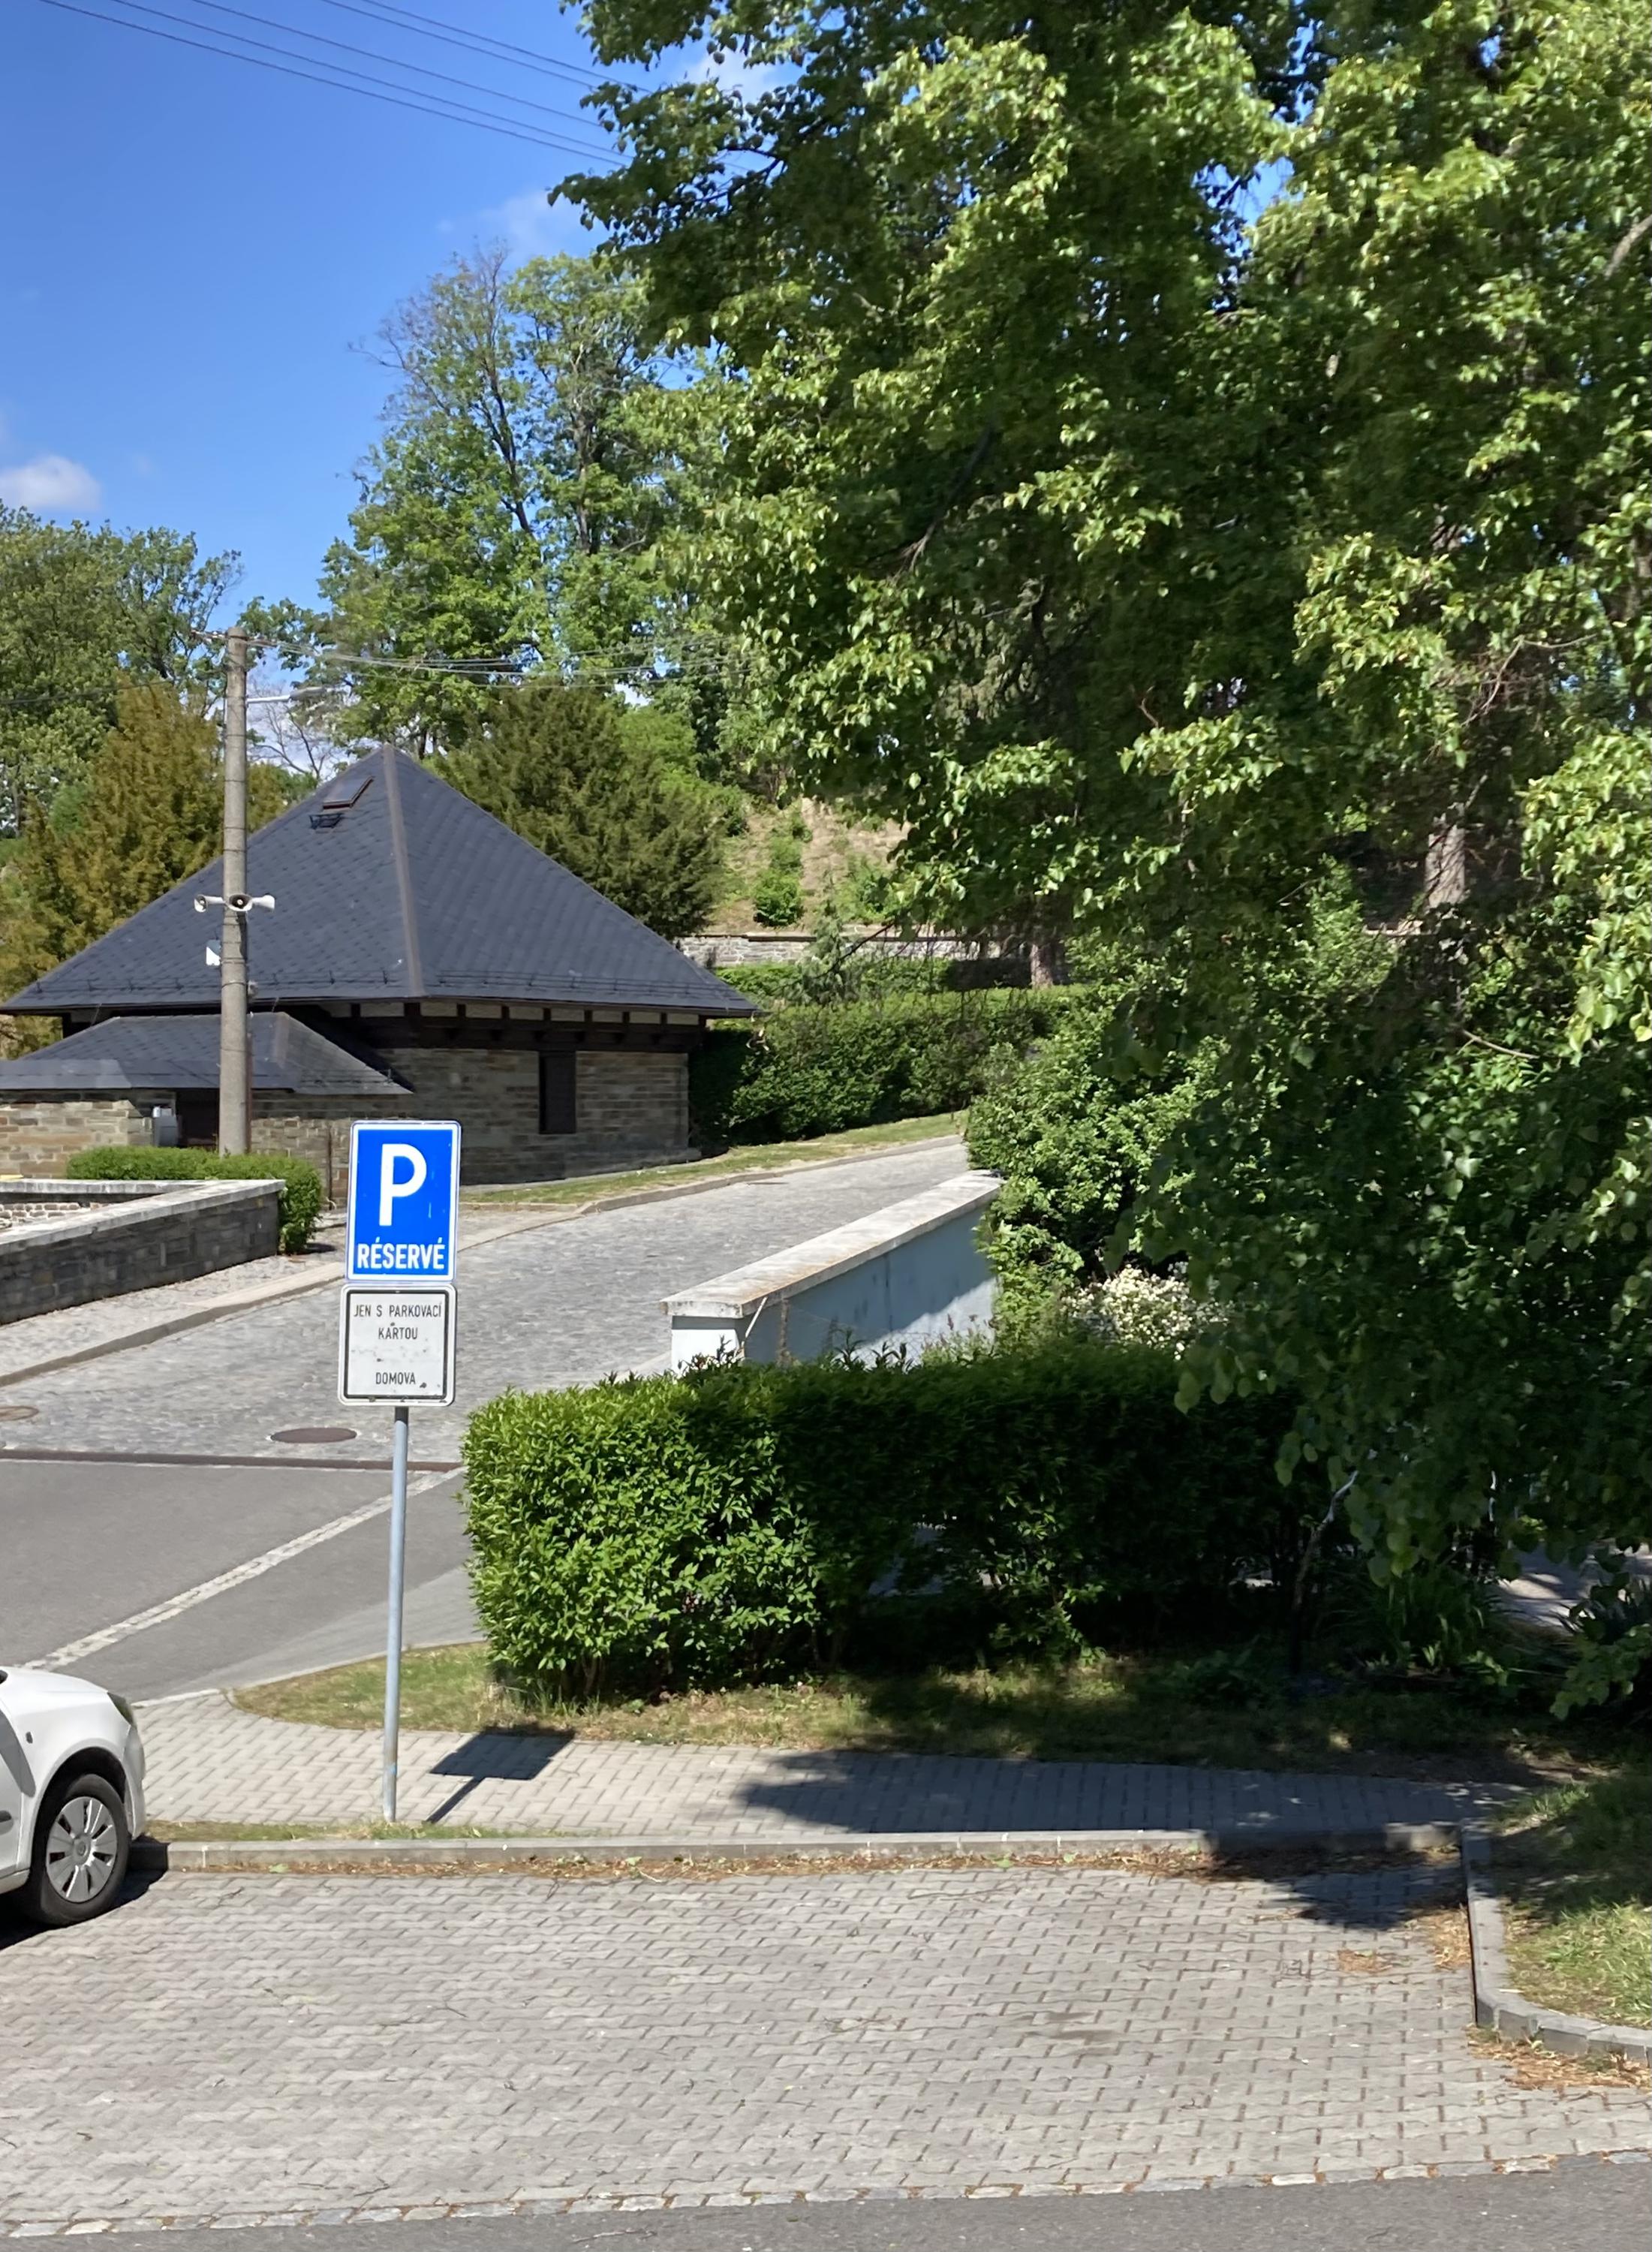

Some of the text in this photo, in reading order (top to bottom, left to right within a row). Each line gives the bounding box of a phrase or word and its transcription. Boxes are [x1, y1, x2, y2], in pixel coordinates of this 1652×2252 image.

[379, 1143, 427, 1227] P
[357, 1236, 446, 1269] RÉSERVÉ
[354, 1301, 442, 1317] JEN S PARKOVACÍ
[378, 1327, 418, 1340] KARTOU
[375, 1371, 417, 1385] DOMOVA
